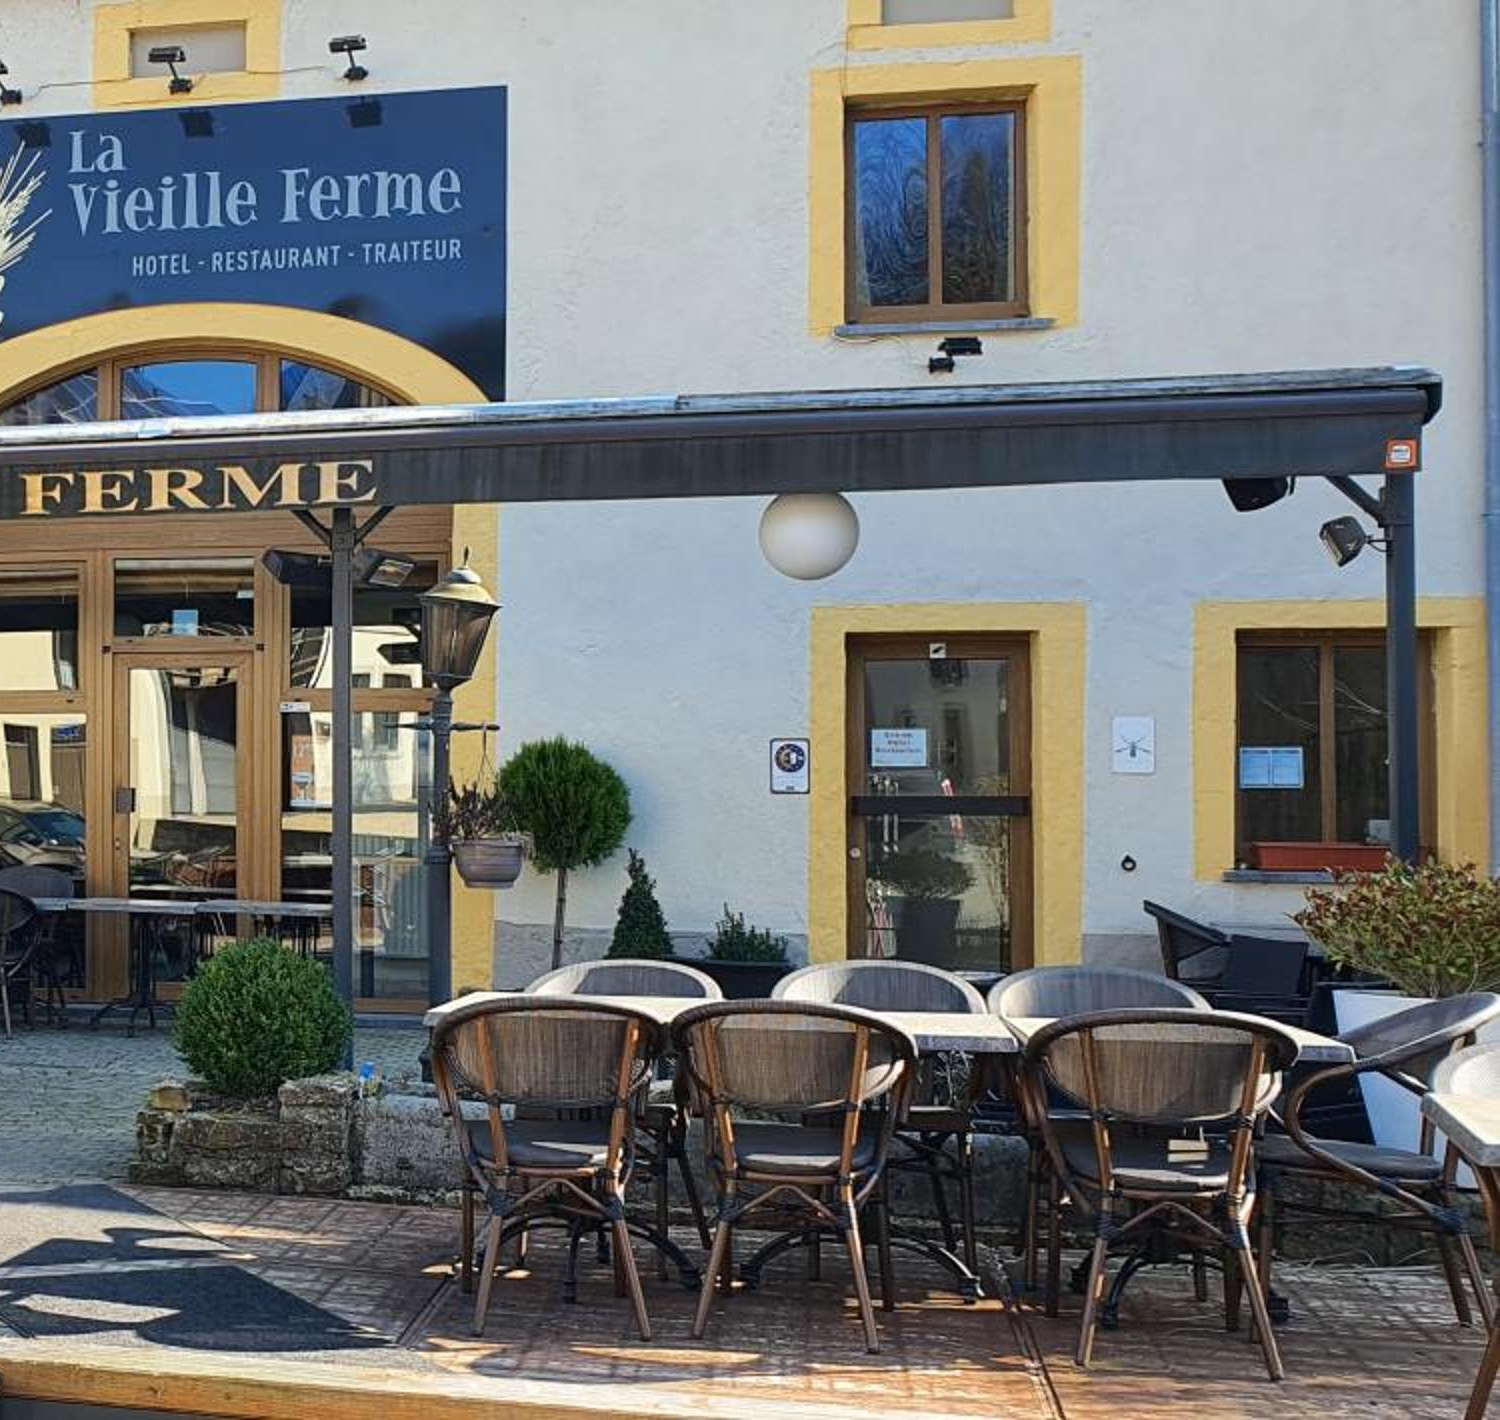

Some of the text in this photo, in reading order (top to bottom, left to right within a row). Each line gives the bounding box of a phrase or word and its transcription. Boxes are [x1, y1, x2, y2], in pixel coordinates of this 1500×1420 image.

[68, 130, 127, 173] La
[68, 167, 462, 237] Vieille Ferme
[132, 254, 191, 277] HOTEL
[212, 245, 341, 273] RESTAURANT
[362, 239, 462, 264] TRAITEUR
[20, 459, 378, 516] FERME
